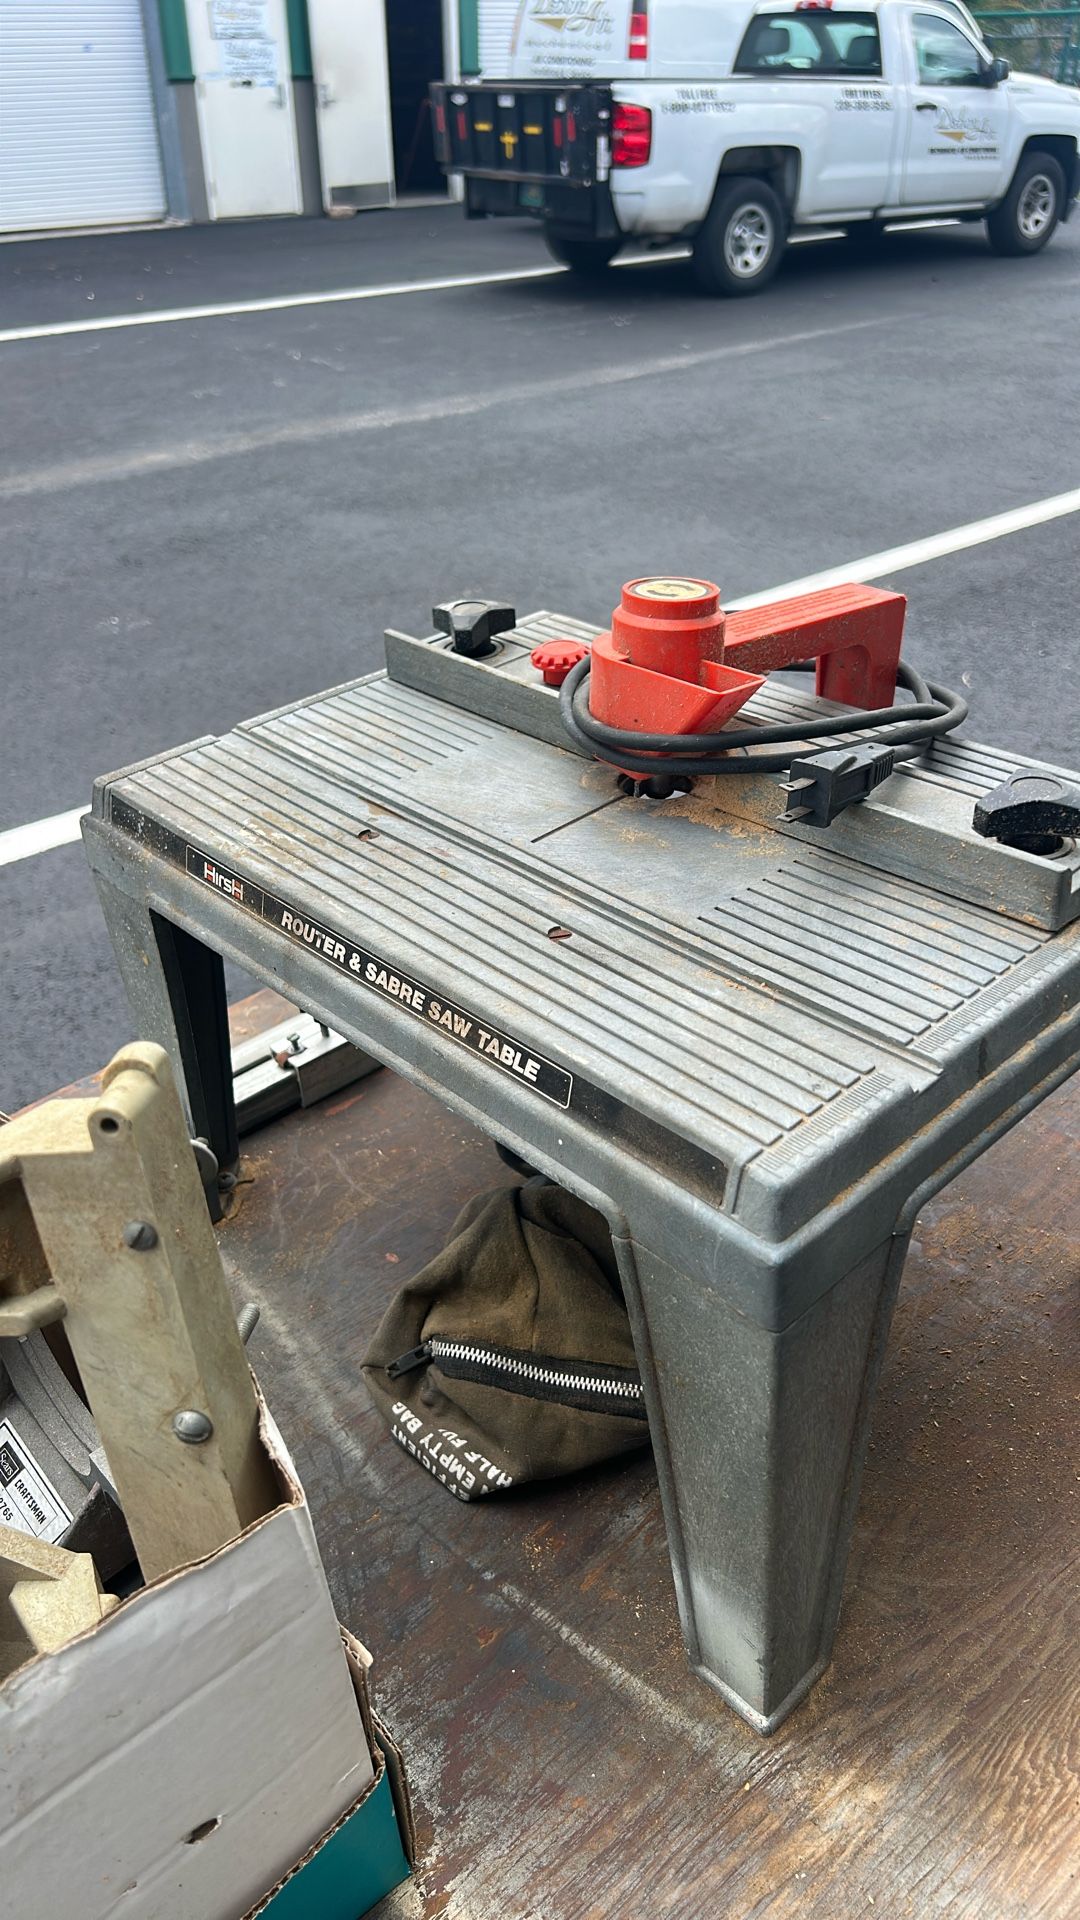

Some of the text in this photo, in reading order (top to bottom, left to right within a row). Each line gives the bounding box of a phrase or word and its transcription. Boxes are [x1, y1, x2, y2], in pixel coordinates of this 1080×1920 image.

[281, 911, 542, 1083] ROUTER & SABRE SAW TABLE
[1, 1453, 14, 1476] Sears
[419, 1433, 476, 1489] EMPTY
[464, 1452, 513, 1488] HALF
[14, 1478, 47, 1525] CRAFTSMAN
